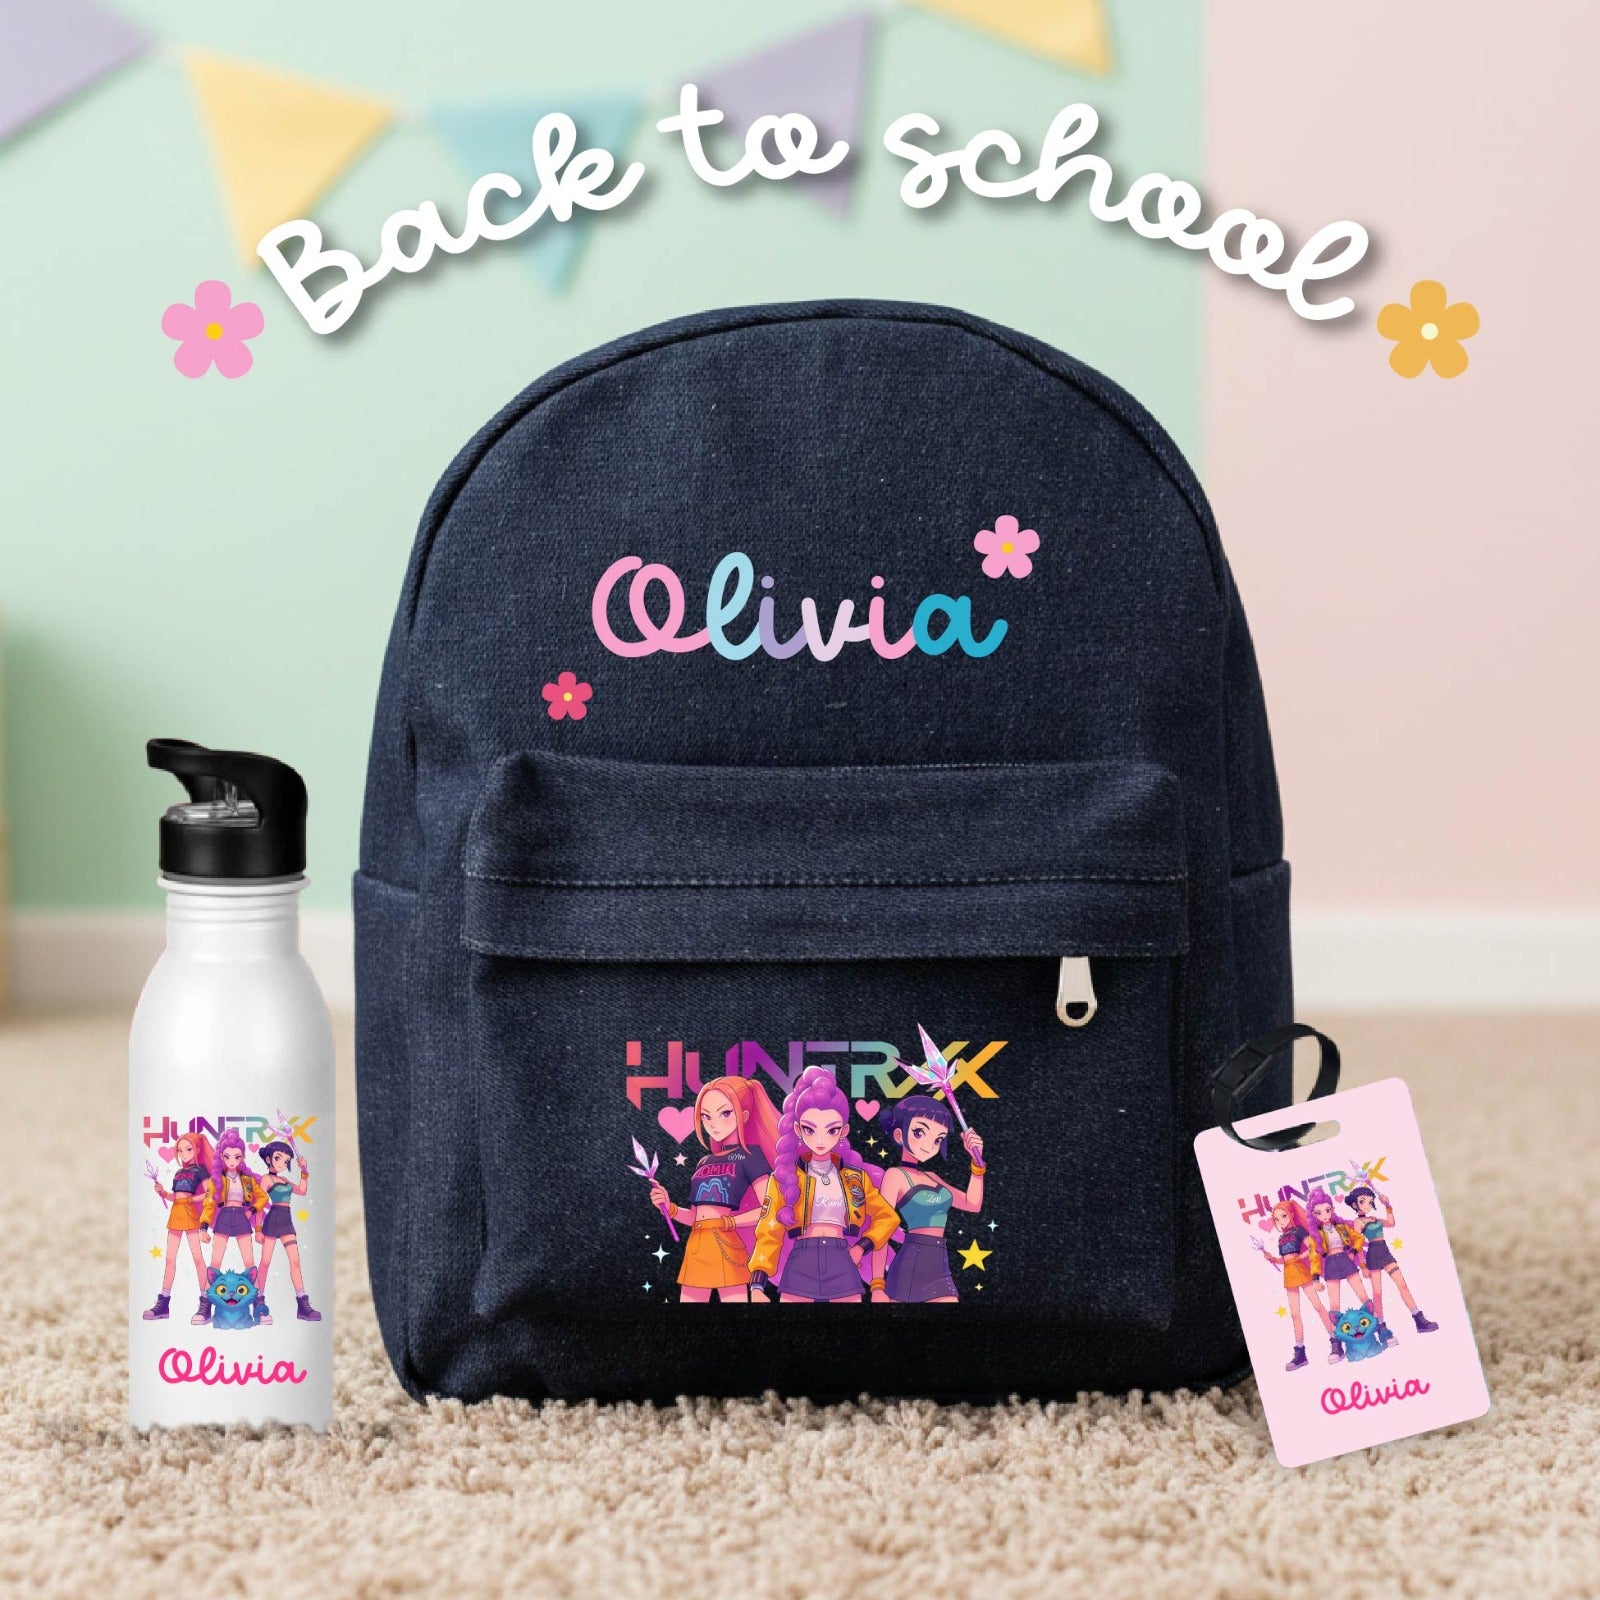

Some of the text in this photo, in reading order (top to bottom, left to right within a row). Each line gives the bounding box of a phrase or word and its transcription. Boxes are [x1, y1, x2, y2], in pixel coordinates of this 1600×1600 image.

[591, 551, 1009, 662] Olivia
[158, 1346, 308, 1386] Olivia
[1320, 1378, 1430, 1415] Olivia
